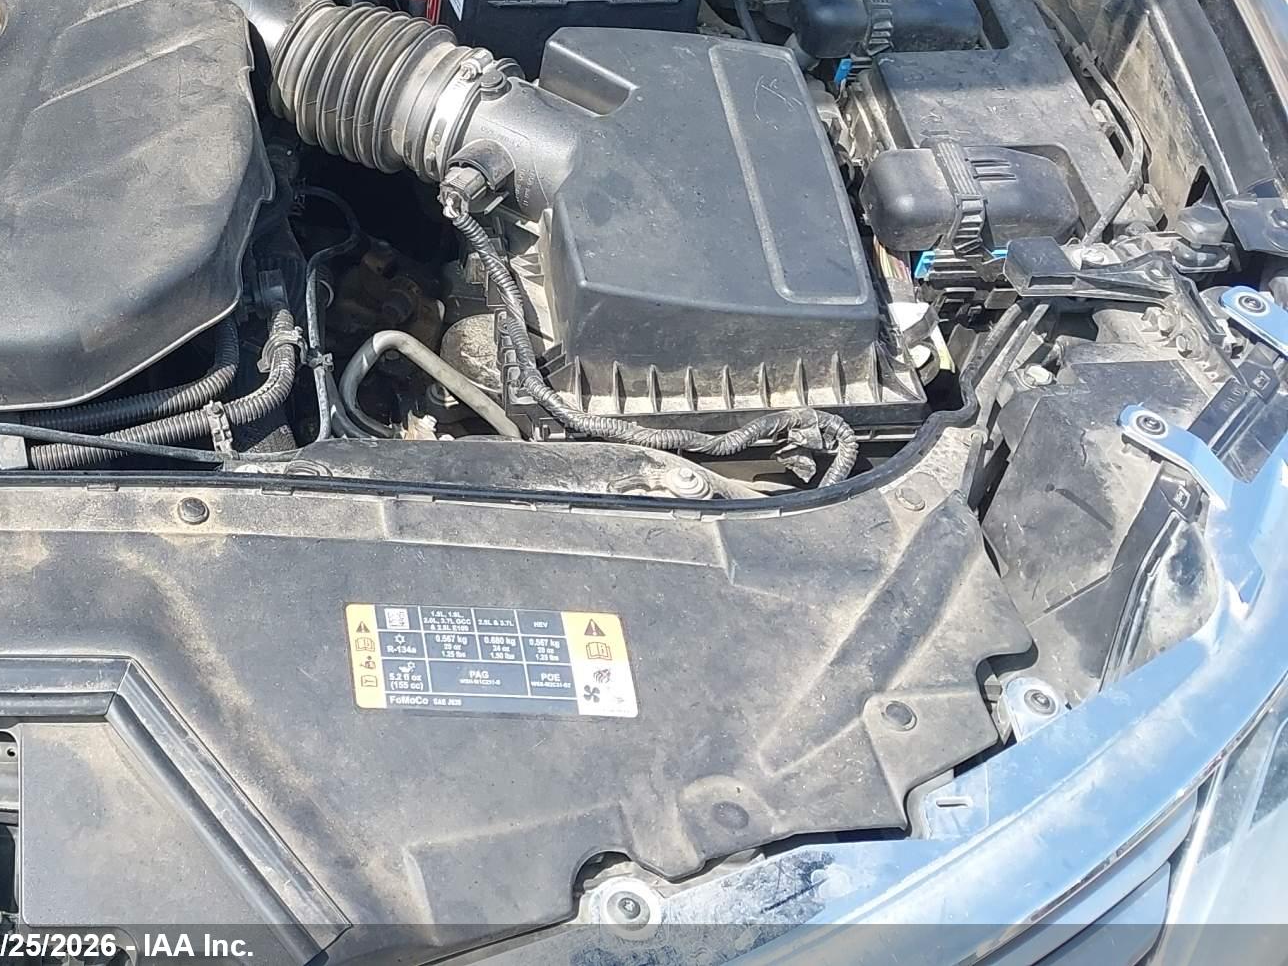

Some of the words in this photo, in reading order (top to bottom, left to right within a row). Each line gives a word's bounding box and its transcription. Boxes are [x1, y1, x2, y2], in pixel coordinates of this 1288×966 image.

[457, 635, 468, 645] kg
[505, 636, 516, 647] kg
[550, 638, 560, 649] kg
[387, 645, 417, 655] R-134a
[389, 672, 402, 680] 5.2
[469, 670, 490, 679] PAG
[540, 672, 561, 682] POE
[390, 681, 409, 690] (155
[410, 681, 424, 691] cc)
[389, 695, 429, 705] FoMoCo
